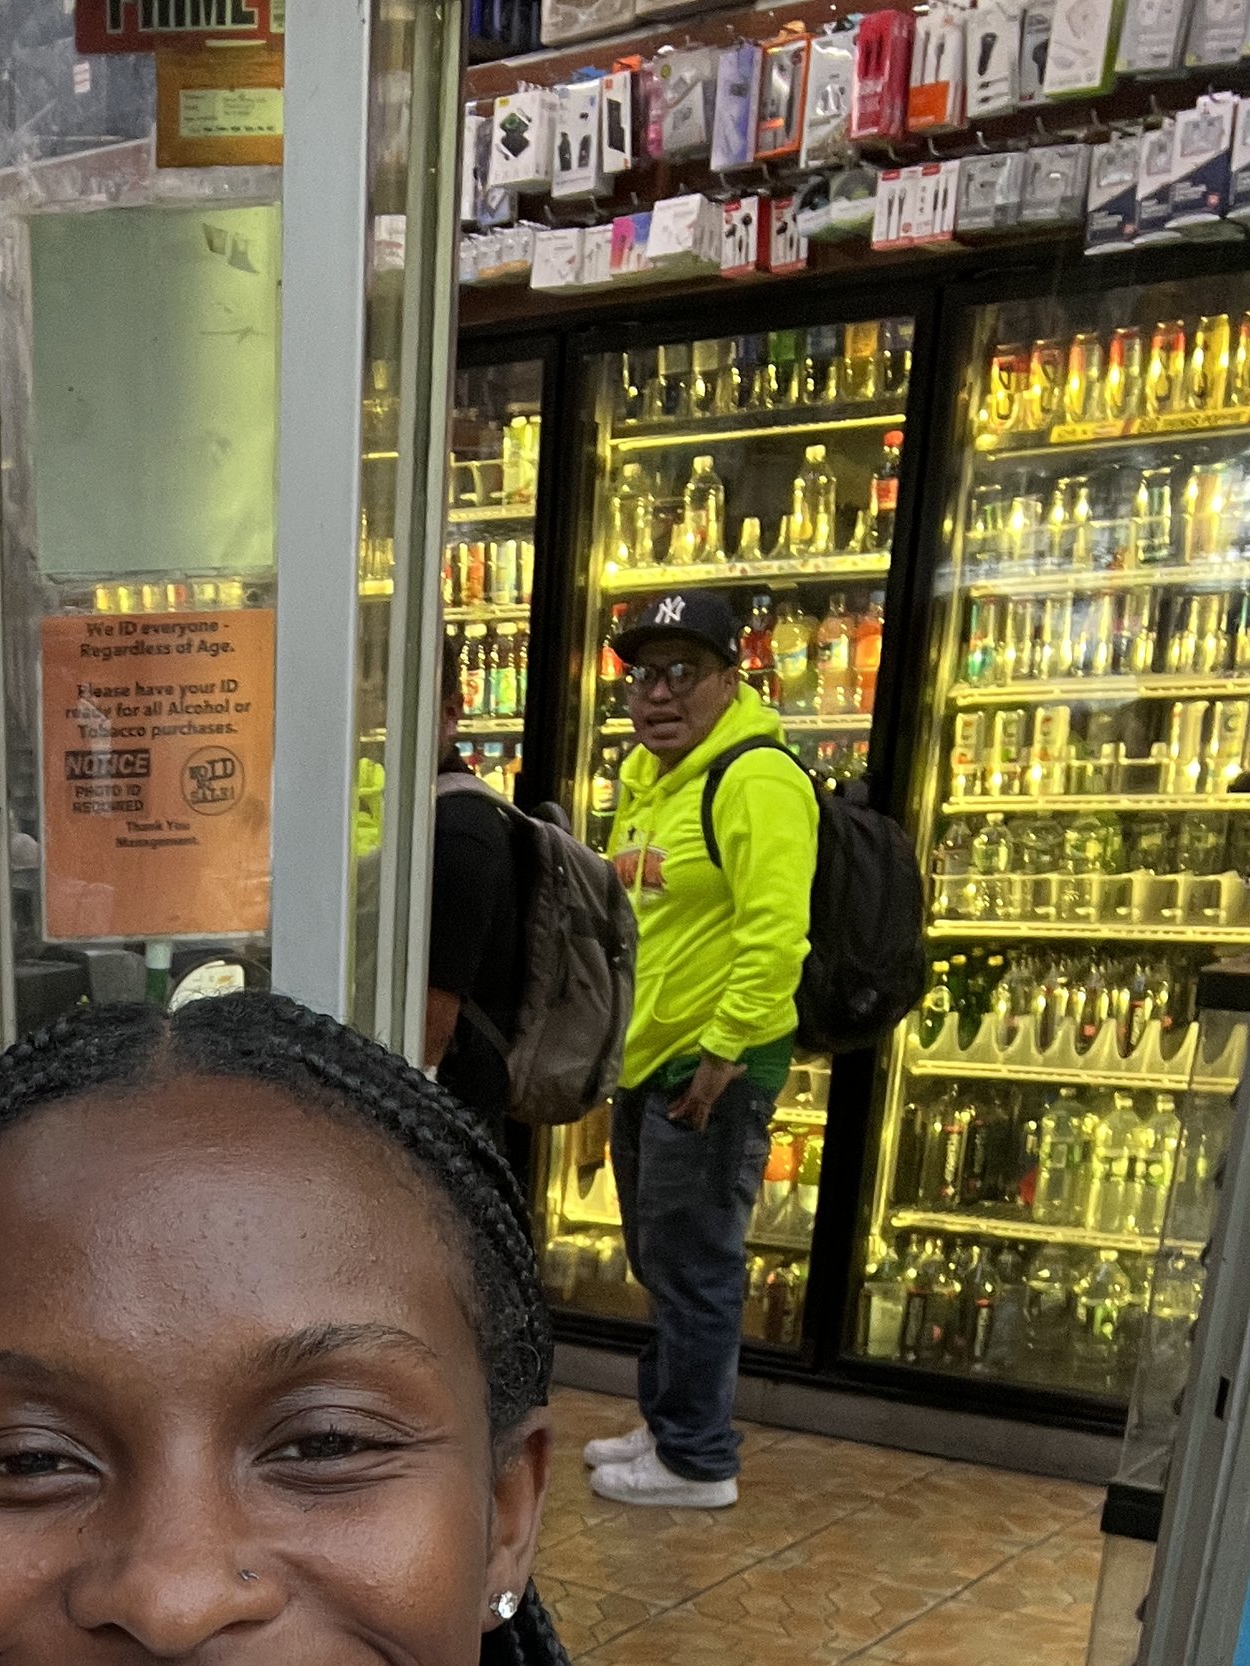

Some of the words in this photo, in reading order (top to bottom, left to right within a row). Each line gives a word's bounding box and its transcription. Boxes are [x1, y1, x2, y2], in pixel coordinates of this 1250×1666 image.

[86, 622, 114, 638] We
[118, 620, 138, 636] ID
[141, 620, 219, 638] everyone
[79, 641, 171, 661] Regardless
[176, 640, 193, 655] of
[196, 640, 235, 658] Age.
[77, 681, 131, 698] Please
[134, 680, 175, 697] have
[179, 682, 216, 702] your
[220, 678, 239, 693] ID
[116, 702, 140, 717] for
[143, 701, 163, 716] all
[168, 699, 230, 715] Alcohol
[235, 702, 252, 713] or
[66, 753, 150, 776] NOTICE
[126, 783, 142, 796] ID
[126, 820, 164, 832] Thank
